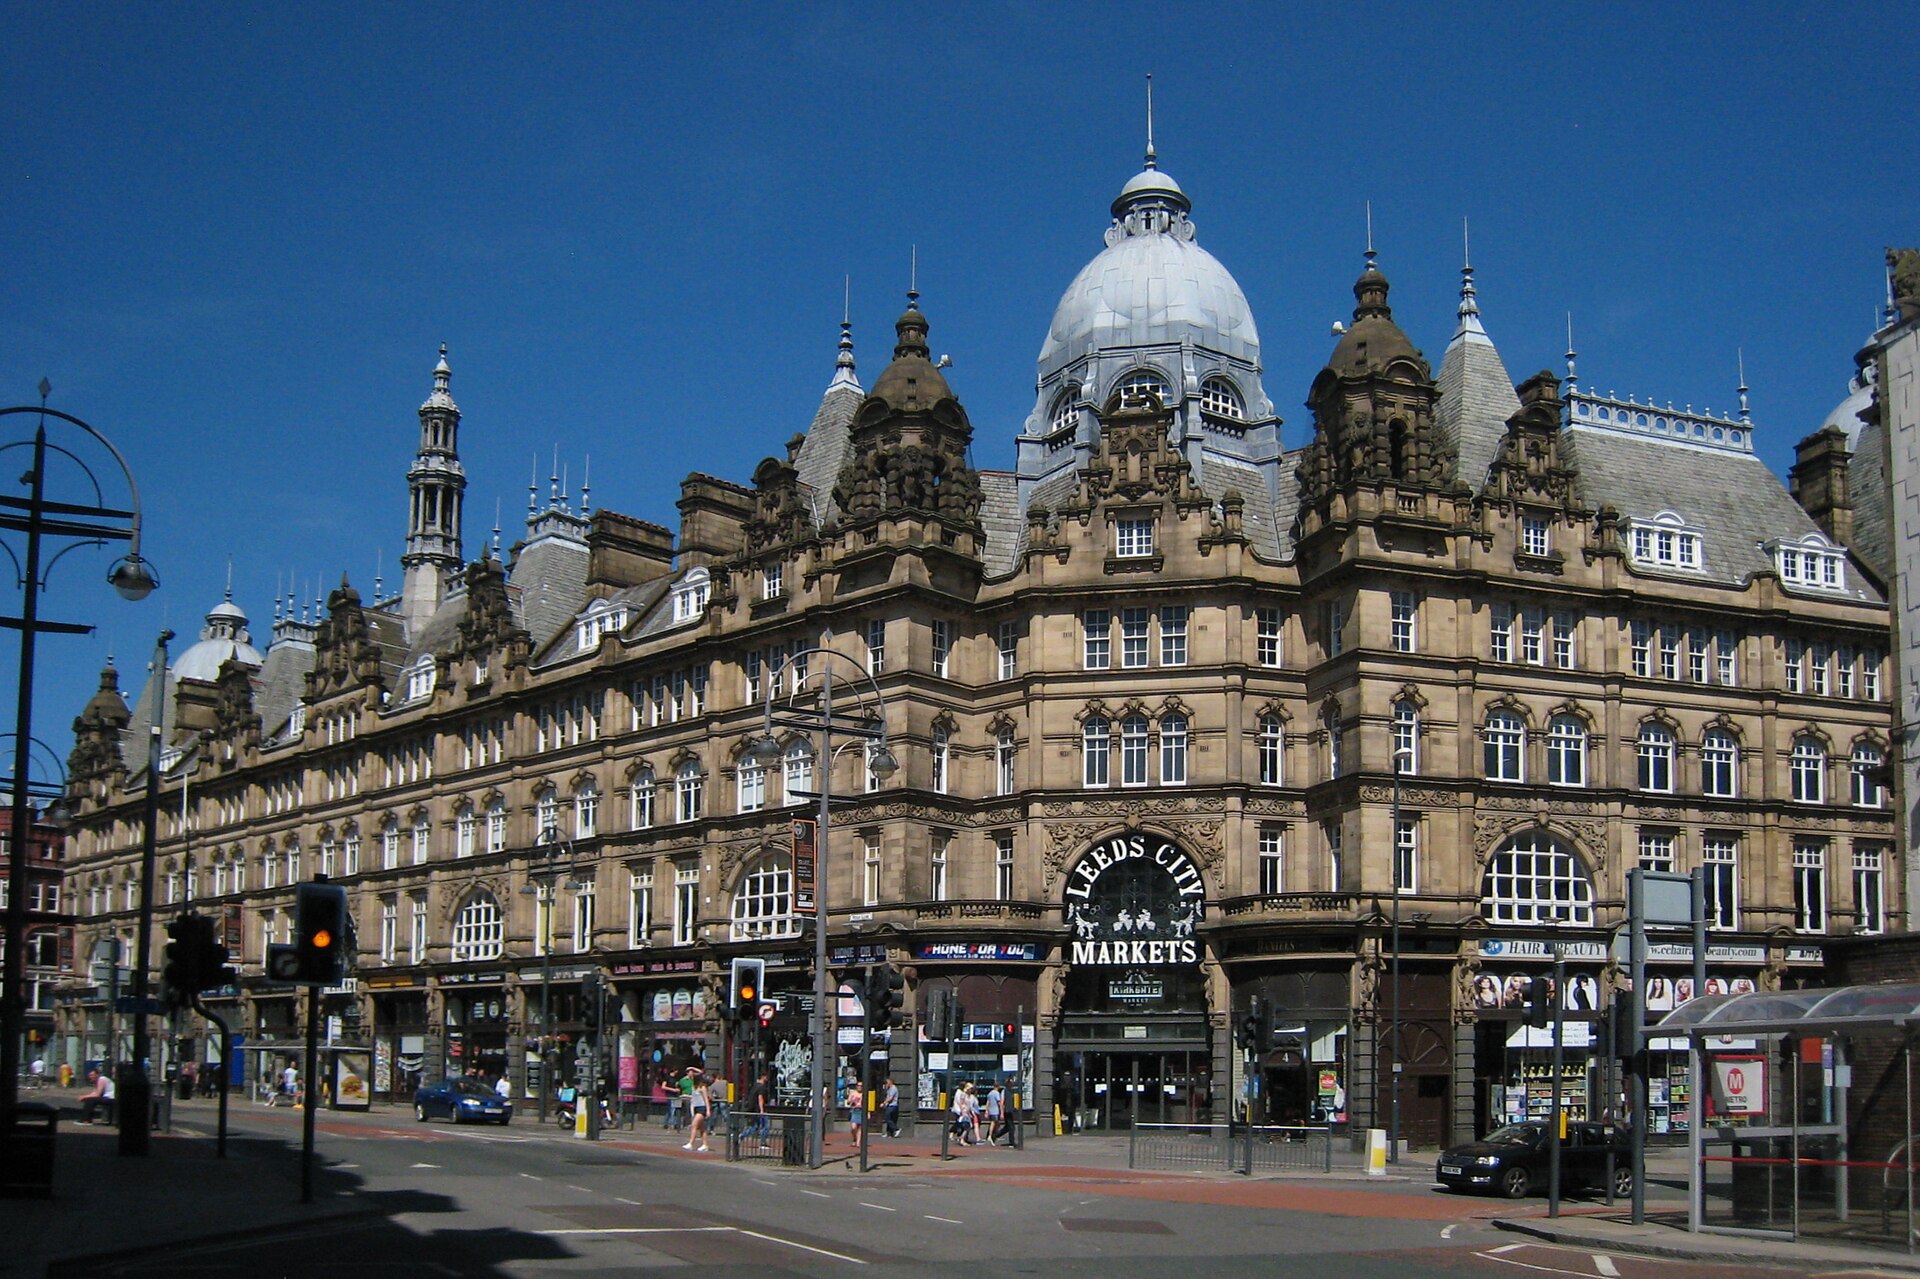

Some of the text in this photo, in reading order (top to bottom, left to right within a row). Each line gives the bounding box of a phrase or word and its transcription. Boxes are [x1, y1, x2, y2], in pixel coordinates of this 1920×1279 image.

[1066, 835, 1204, 899] LEEDS CITY
[924, 943, 1025, 955] PHONE FOR YOU
[1071, 940, 1197, 965] MARKETS
[1509, 941, 1540, 954] HAIR
[1282, 1052, 1289, 1062] 4
